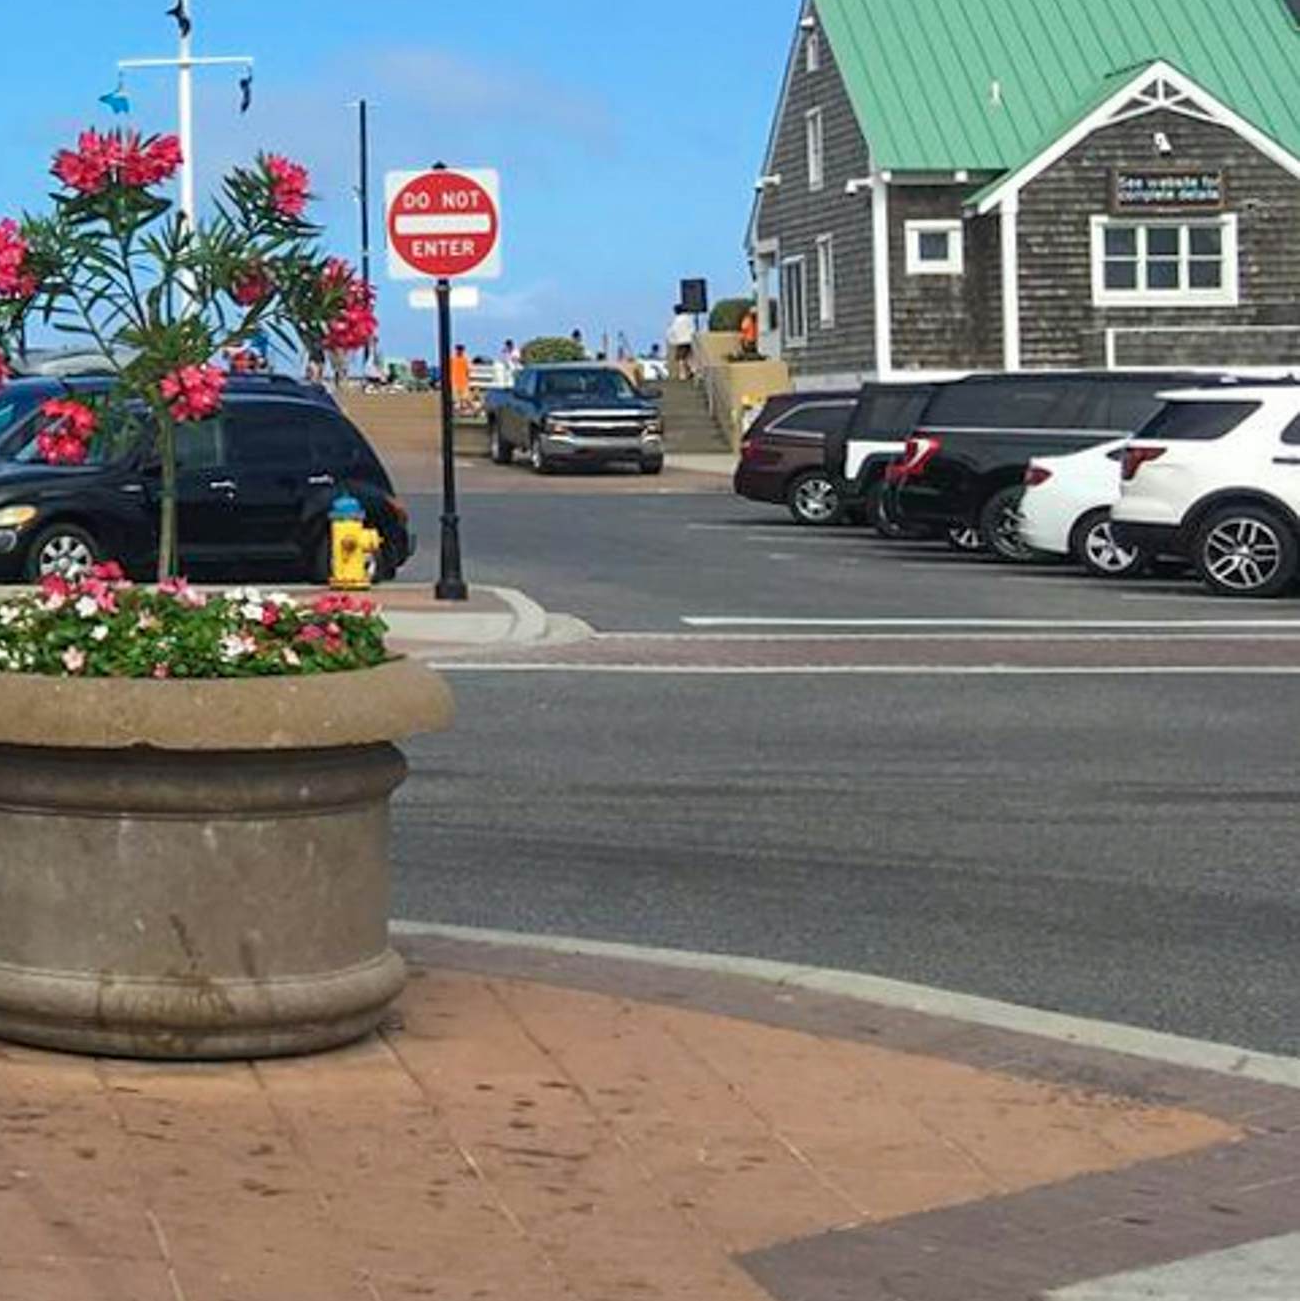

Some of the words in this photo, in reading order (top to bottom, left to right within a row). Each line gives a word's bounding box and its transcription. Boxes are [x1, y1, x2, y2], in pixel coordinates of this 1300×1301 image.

[402, 191, 431, 209] DO
[442, 189, 480, 209] NOT
[411, 240, 475, 257] ENTER
